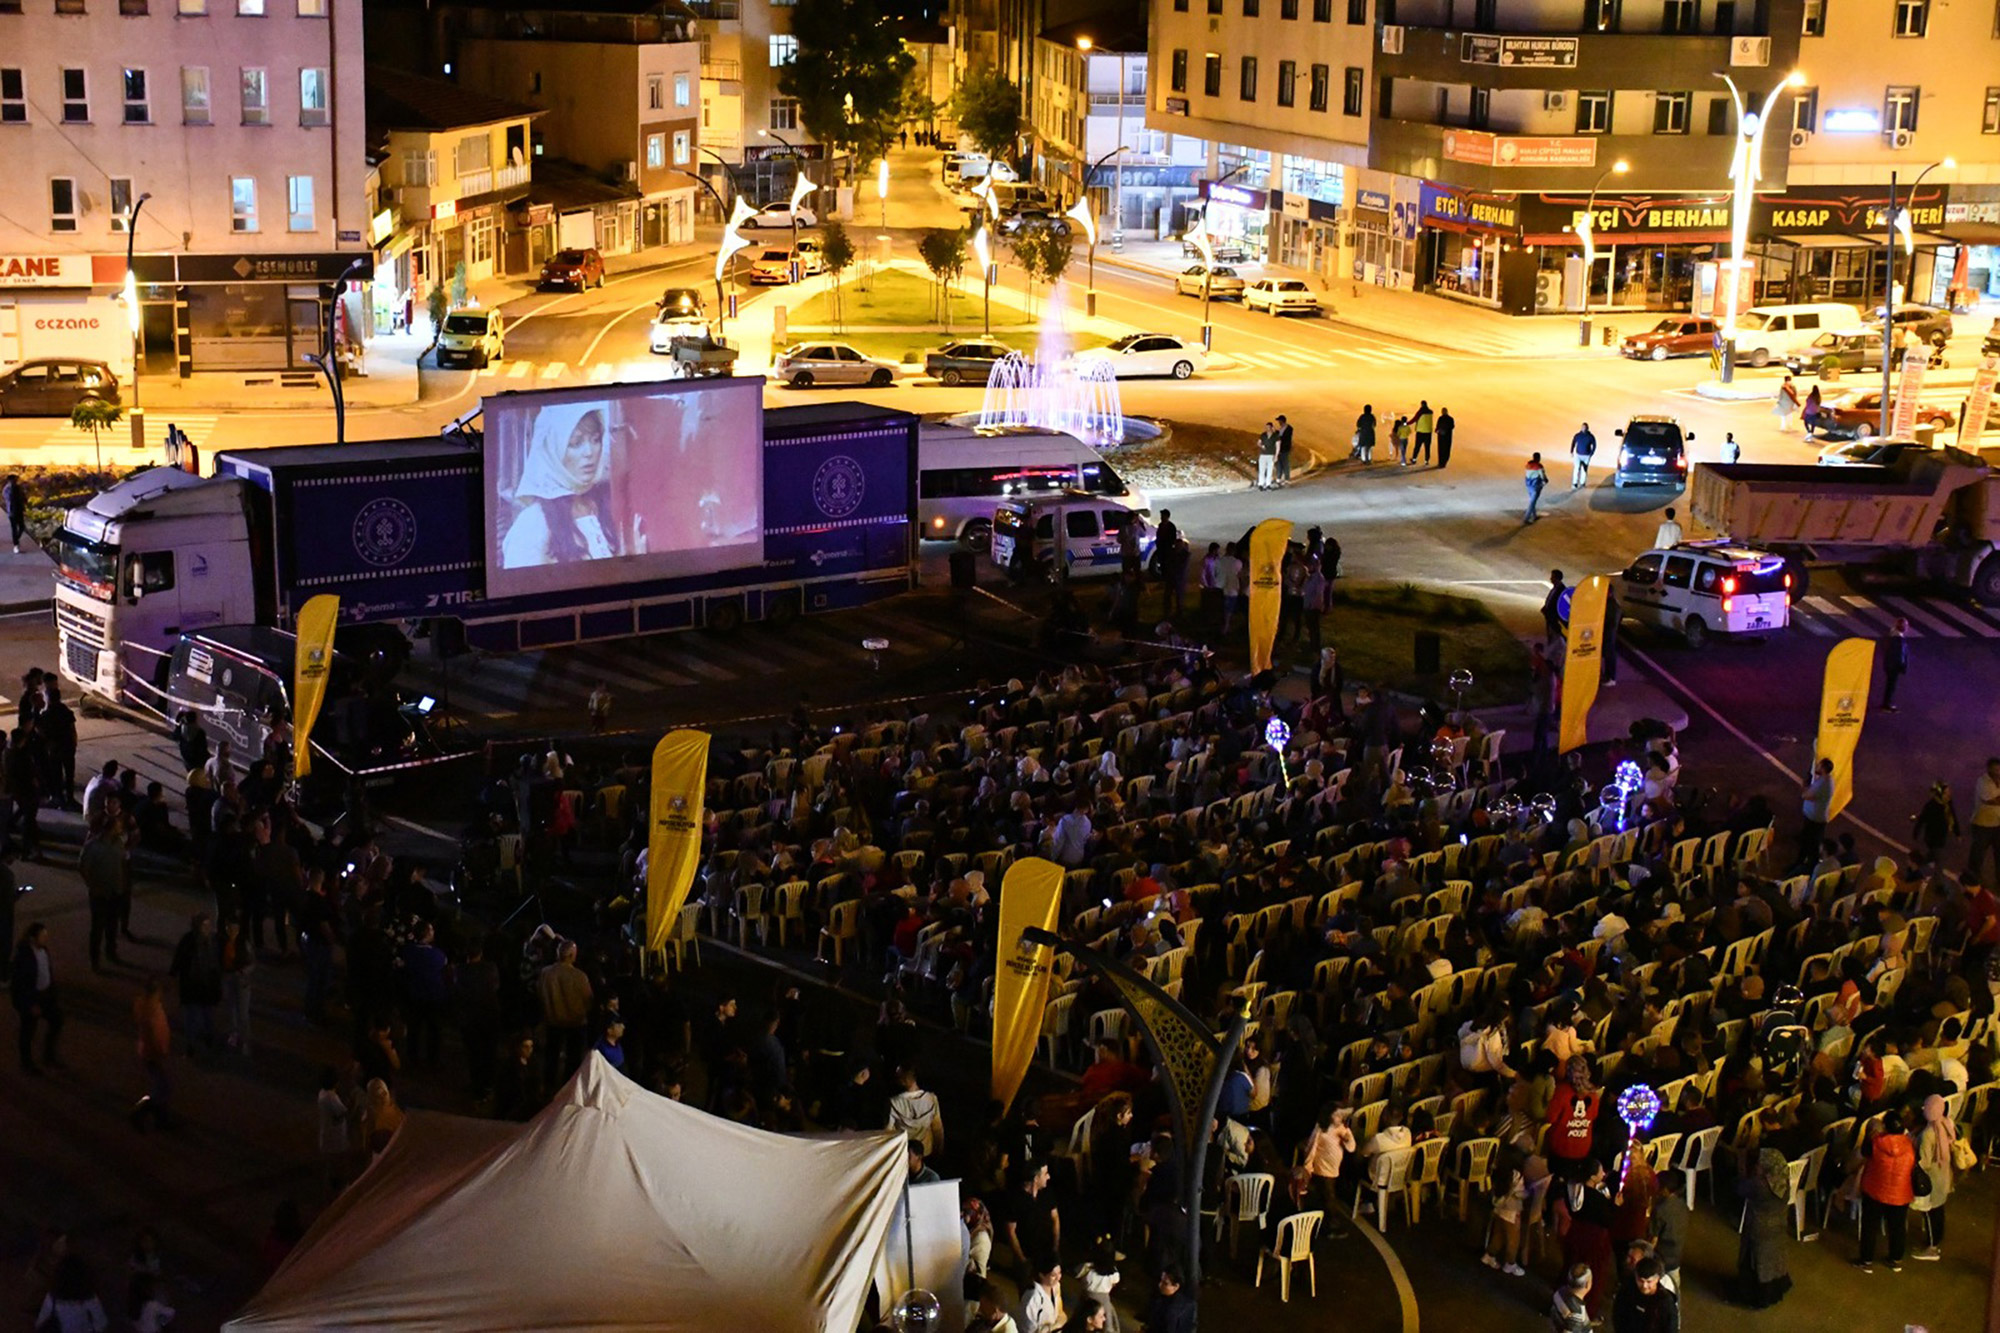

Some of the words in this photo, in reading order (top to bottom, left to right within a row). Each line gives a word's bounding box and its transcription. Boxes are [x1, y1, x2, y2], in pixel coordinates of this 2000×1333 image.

[1435, 196, 1458, 217] ETÇİ
[1472, 203, 1515, 227] BERHAM
[1648, 208, 1729, 228] BERHAM
[1772, 209, 1831, 227] KASAP
[35, 318, 100, 330] eczane
